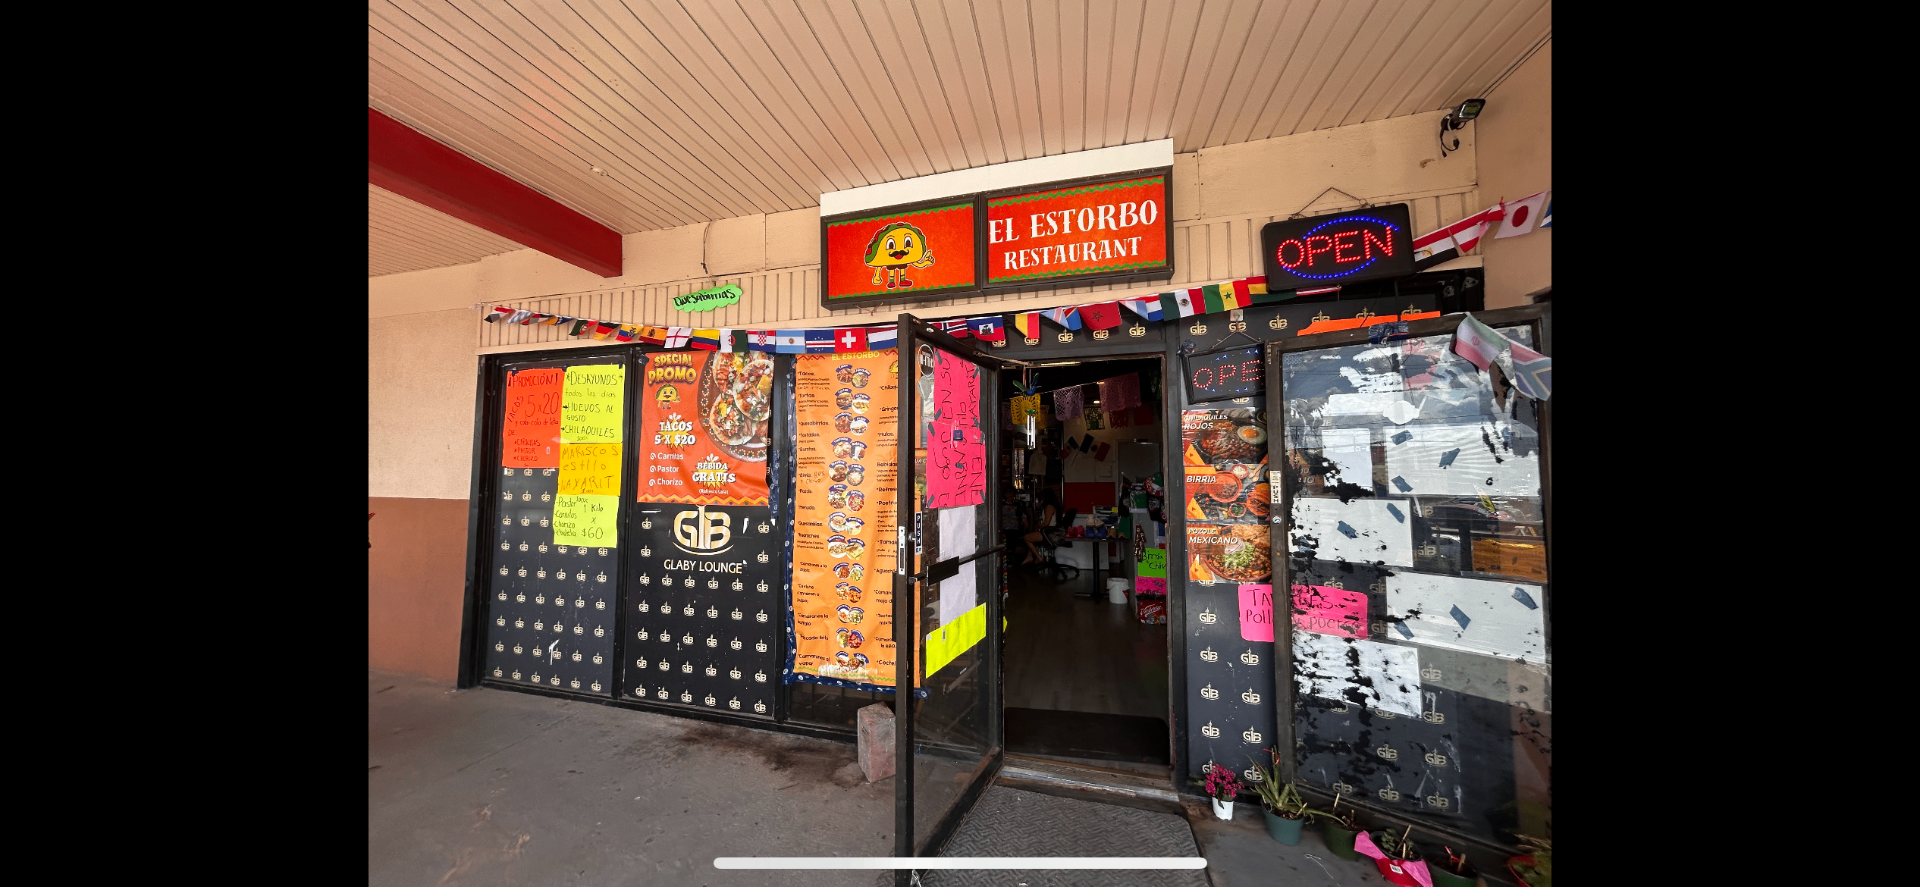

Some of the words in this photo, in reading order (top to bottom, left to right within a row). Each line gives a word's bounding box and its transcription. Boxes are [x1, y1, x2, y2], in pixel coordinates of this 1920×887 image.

[988, 217, 1019, 245] EL
[1030, 199, 1158, 238] ESTORBO
[1277, 226, 1393, 268] OPEN
[1003, 236, 1142, 270] RESTAURANT
[654, 354, 692, 367] SPECIAL
[648, 366, 697, 384] PROMO
[659, 421, 693, 432] TACOS
[1184, 422, 1213, 430] ROJOS
[654, 435, 661, 445] 5
[674, 434, 696, 445] $20
[657, 452, 684, 460] Carnitas
[657, 465, 680, 473] Pastor
[697, 462, 728, 470] BEBIDA
[657, 478, 683, 486] Chorizo
[692, 471, 737, 483] GRATIS
[1186, 475, 1217, 483] BIRRIA
[581, 527, 604, 539] $60
[1189, 536, 1238, 544] MEXICANO
[664, 559, 697, 571] GLABY
[699, 561, 743, 574] LOUNGE
